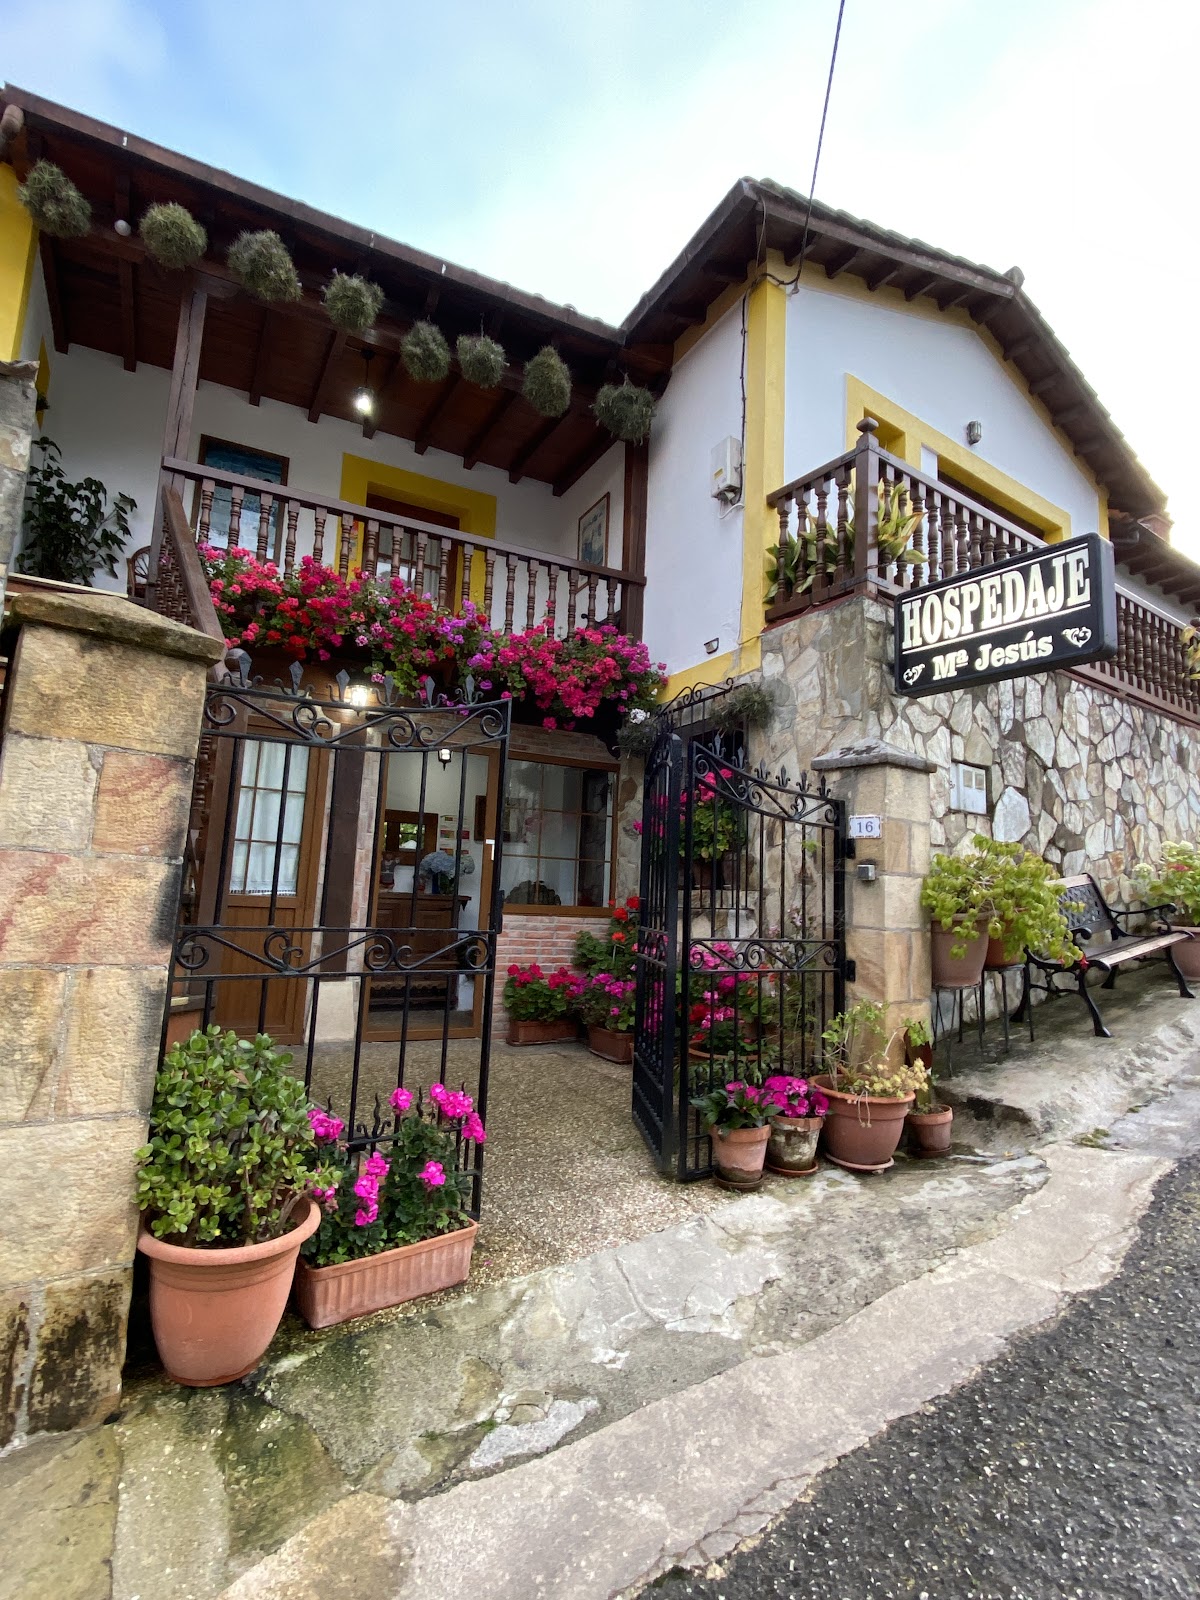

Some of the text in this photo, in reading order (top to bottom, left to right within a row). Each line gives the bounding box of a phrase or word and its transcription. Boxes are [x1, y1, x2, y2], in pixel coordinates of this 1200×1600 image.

[902, 548, 1091, 649] HOSPEDAJE
[931, 630, 1054, 681] Mª Jesús
[857, 821, 874, 833] 16
